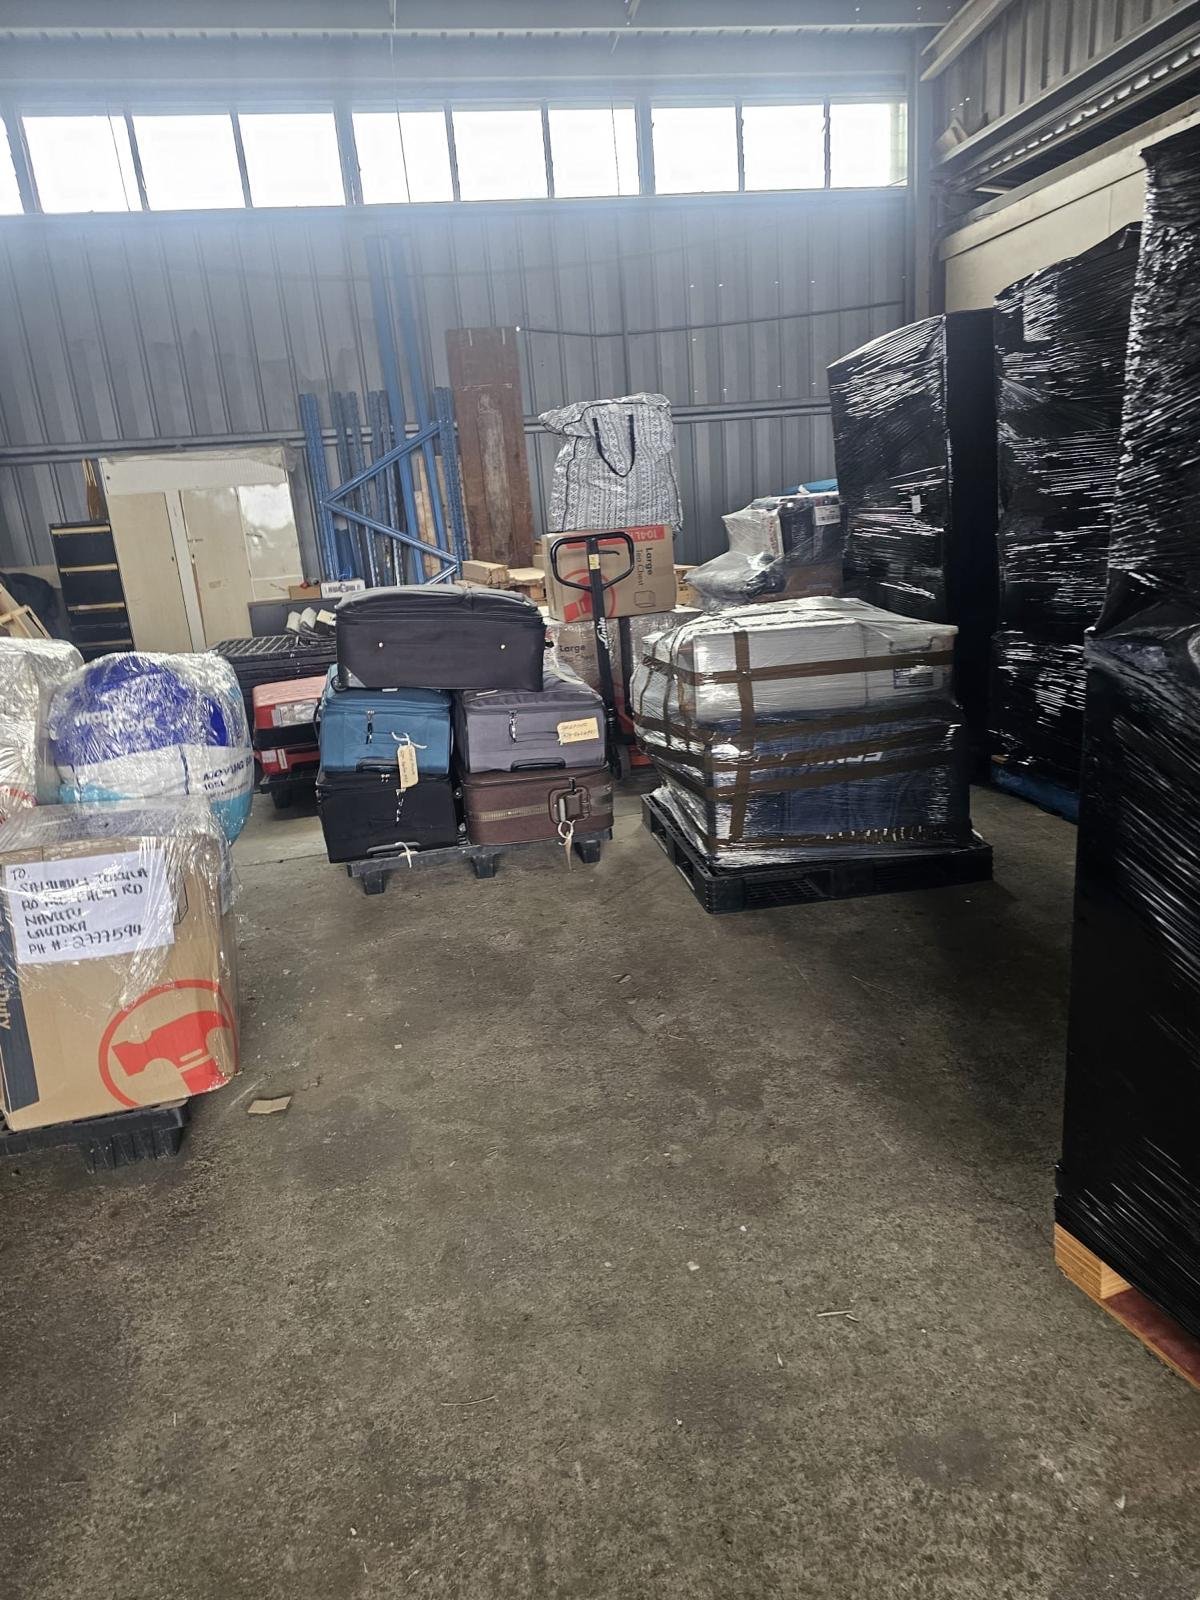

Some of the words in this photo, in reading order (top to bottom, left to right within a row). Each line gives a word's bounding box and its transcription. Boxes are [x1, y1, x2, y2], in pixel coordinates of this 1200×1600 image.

[645, 547, 653, 575] Large
[558, 644, 586, 654] Large
[121, 884, 143, 896] RD
[27, 921, 87, 939] LAUTOKA
